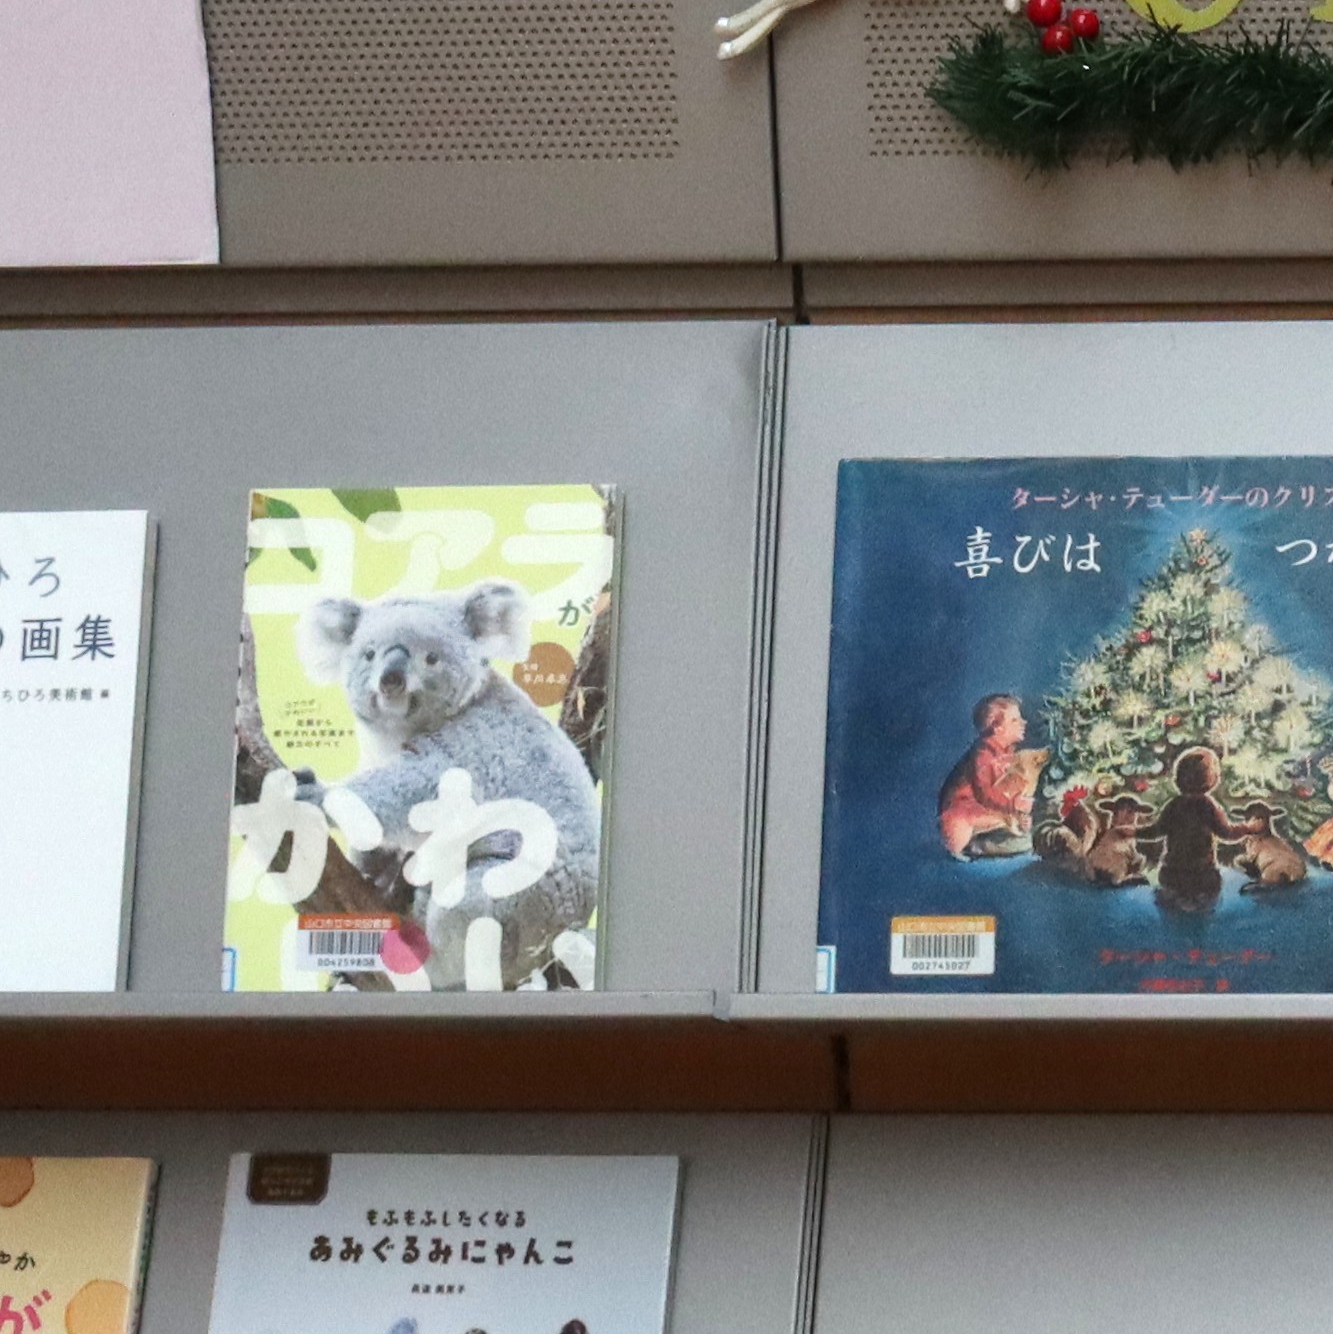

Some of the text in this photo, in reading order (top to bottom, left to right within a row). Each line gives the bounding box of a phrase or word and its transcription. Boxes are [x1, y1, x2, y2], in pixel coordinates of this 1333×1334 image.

[953, 531, 1102, 579] 喜びは
[558, 597, 595, 626] が
[0, 614, 116, 662] 画集
[228, 768, 558, 907] かわ
[366, 1209, 528, 1227] もふもふしたくなる
[309, 1234, 575, 1266] あみぐるみにゃんこ
